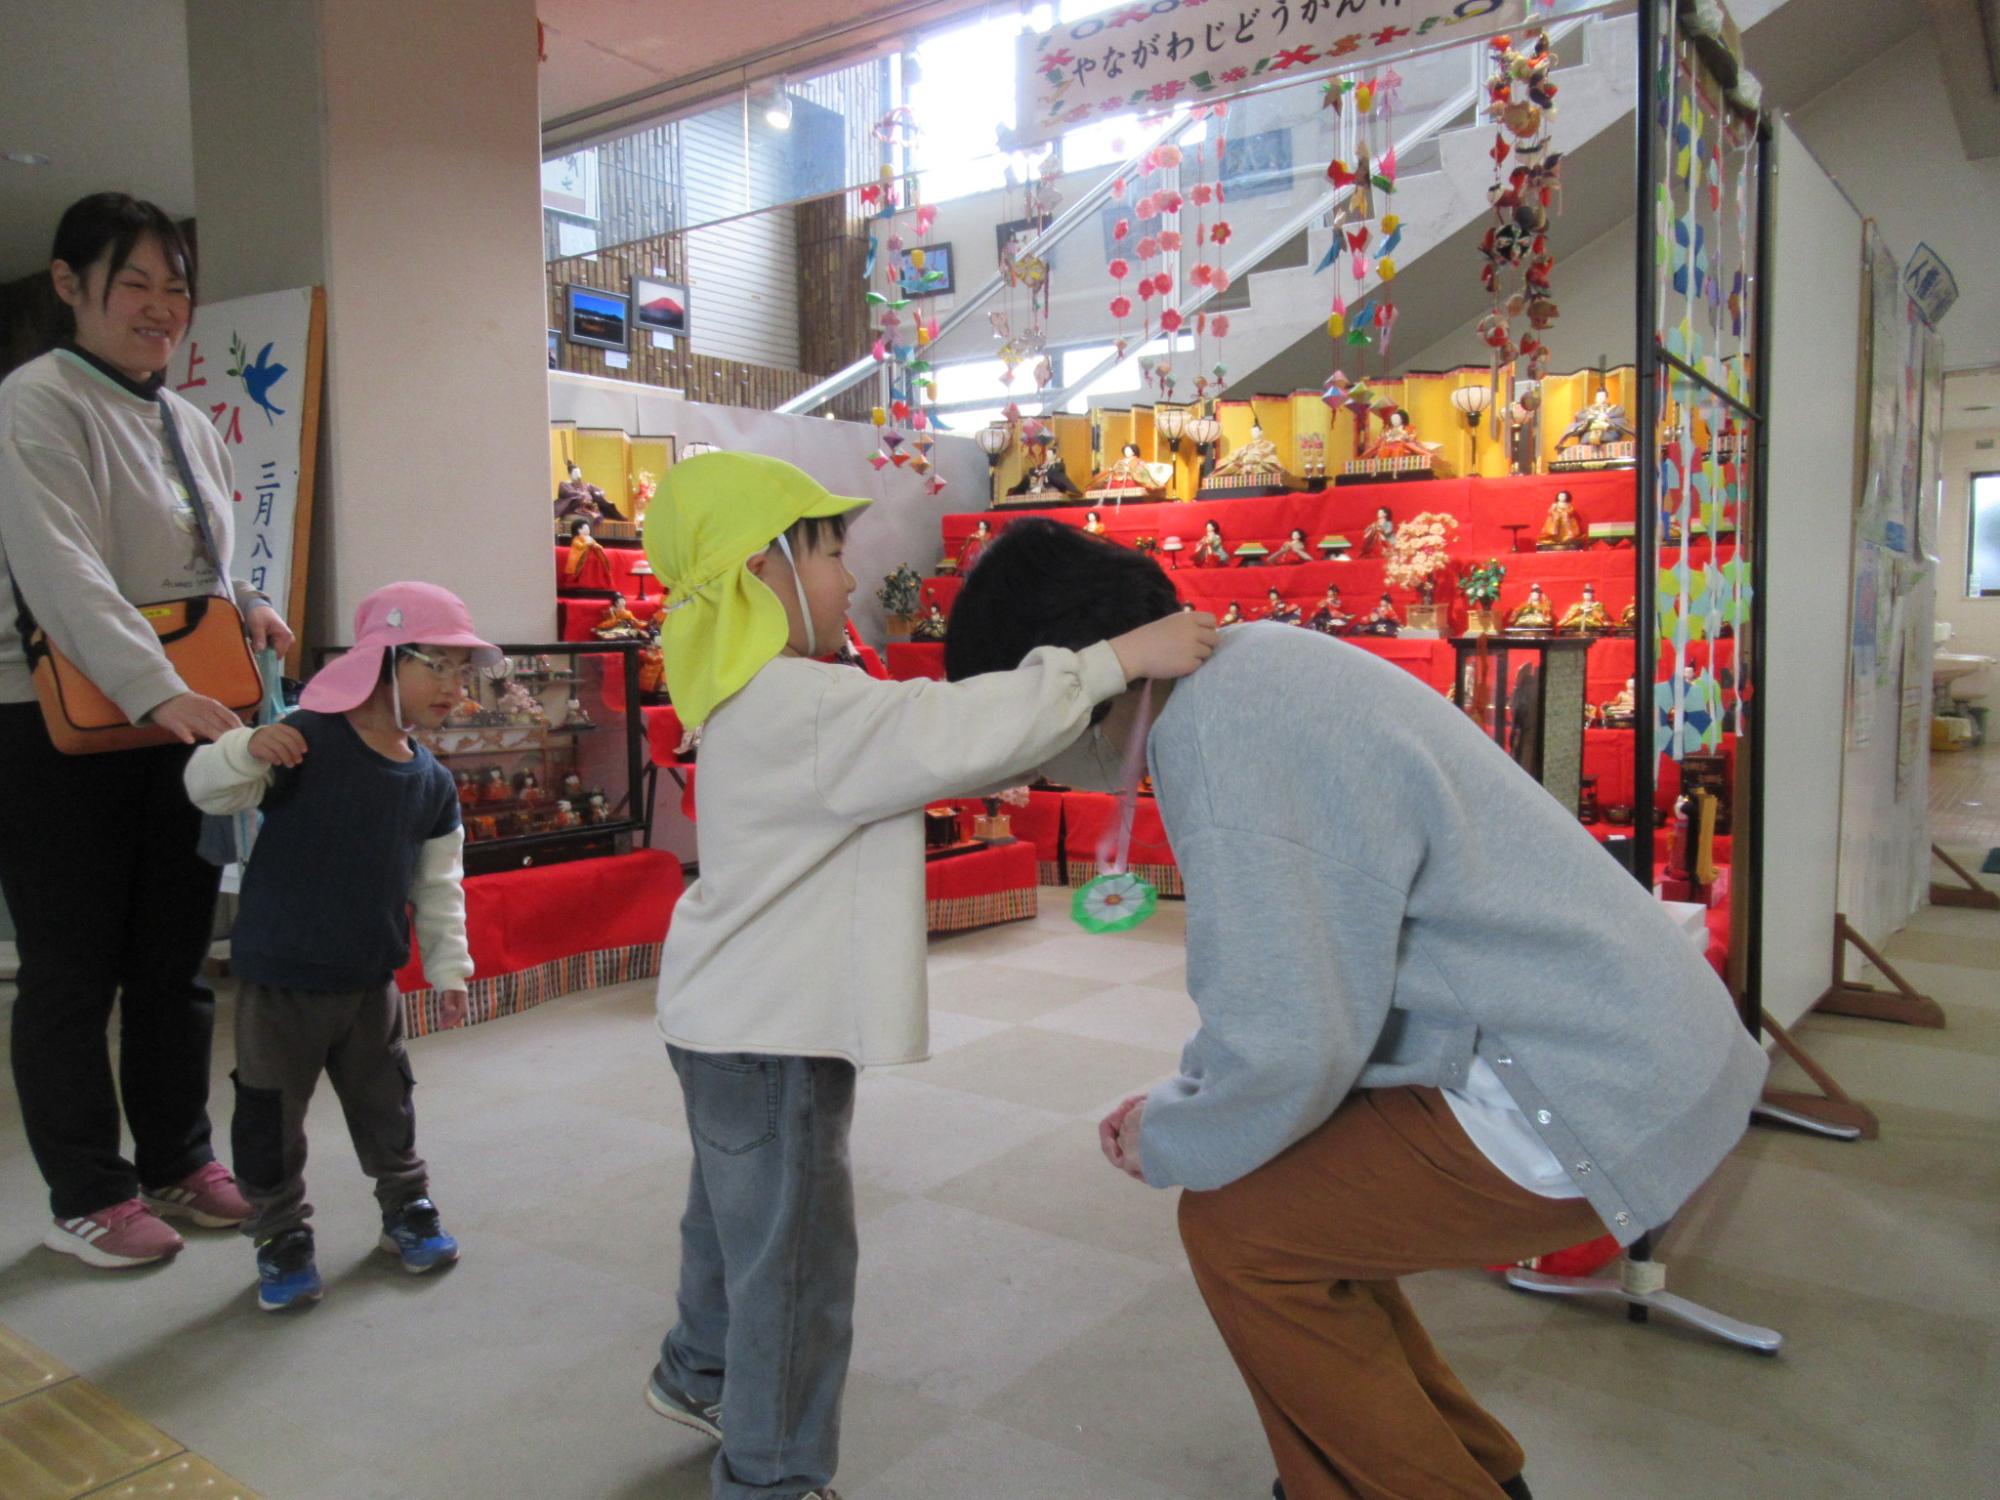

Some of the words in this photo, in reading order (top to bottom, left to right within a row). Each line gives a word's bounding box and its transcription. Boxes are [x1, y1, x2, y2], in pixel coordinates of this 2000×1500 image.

[1073, 0, 1401, 88] やながわじどうかん
[250, 460, 281, 591] 三月八日
